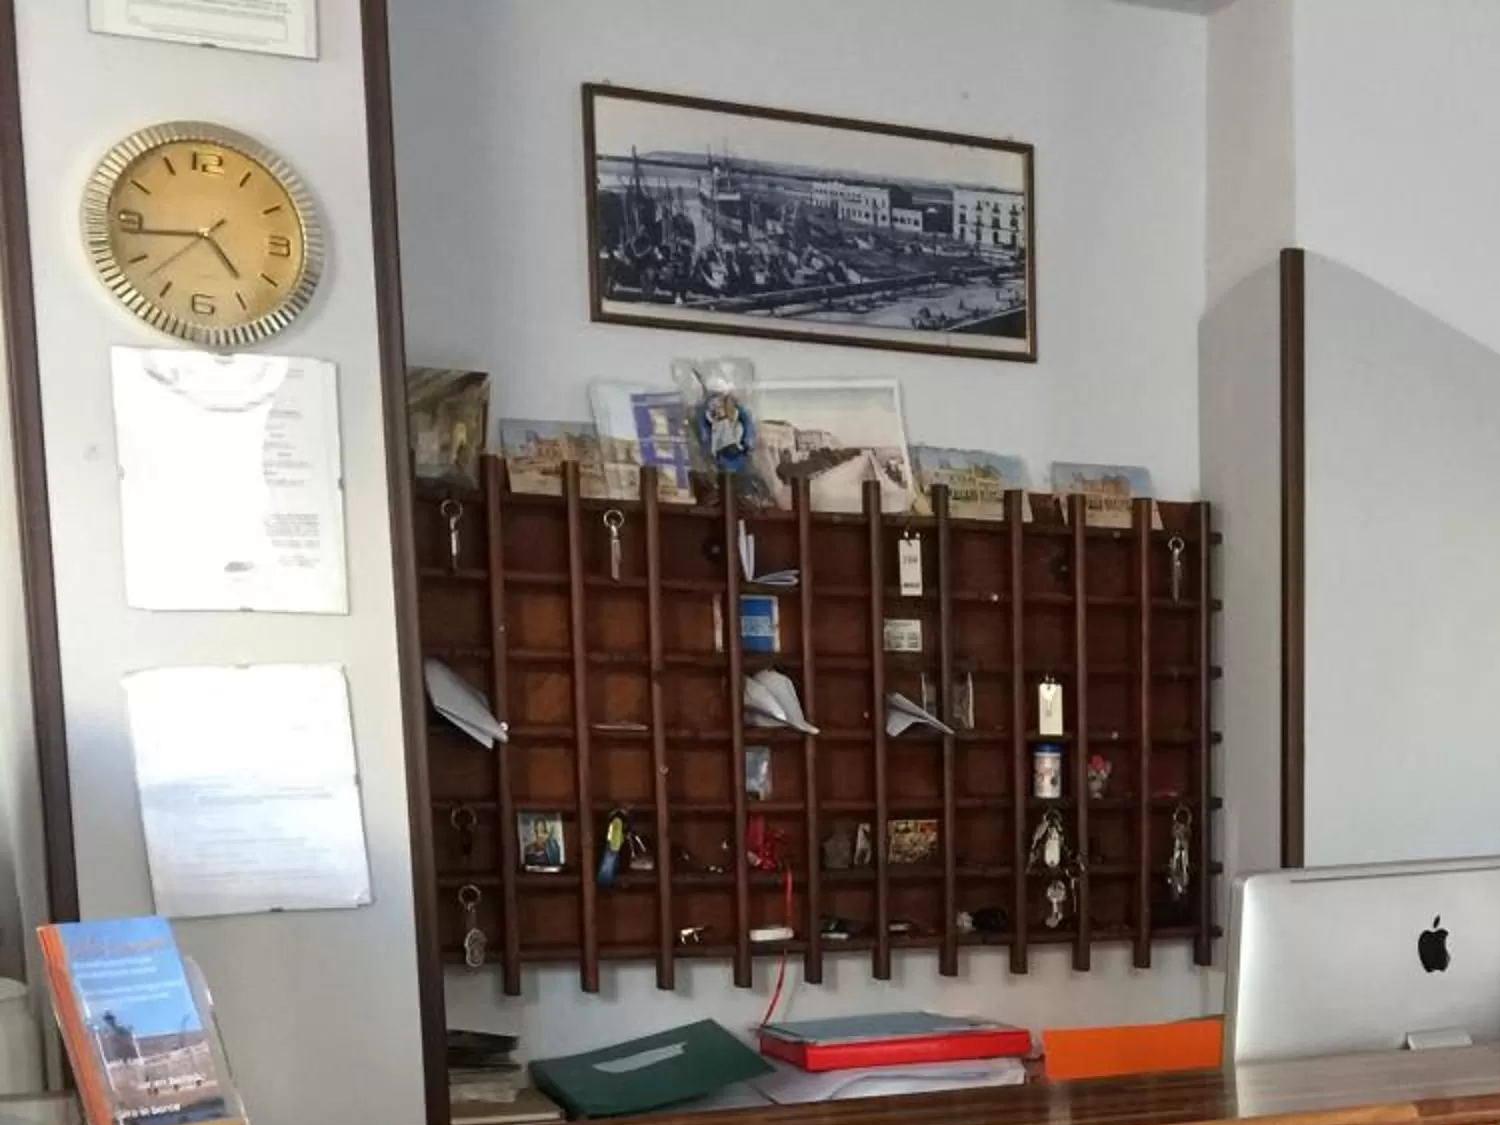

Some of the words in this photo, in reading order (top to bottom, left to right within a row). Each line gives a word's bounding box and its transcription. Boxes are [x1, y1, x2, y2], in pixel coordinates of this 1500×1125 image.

[192, 152, 224, 177] 12
[118, 209, 143, 233] 9
[268, 235, 291, 257] 3
[192, 293, 215, 315] 6
